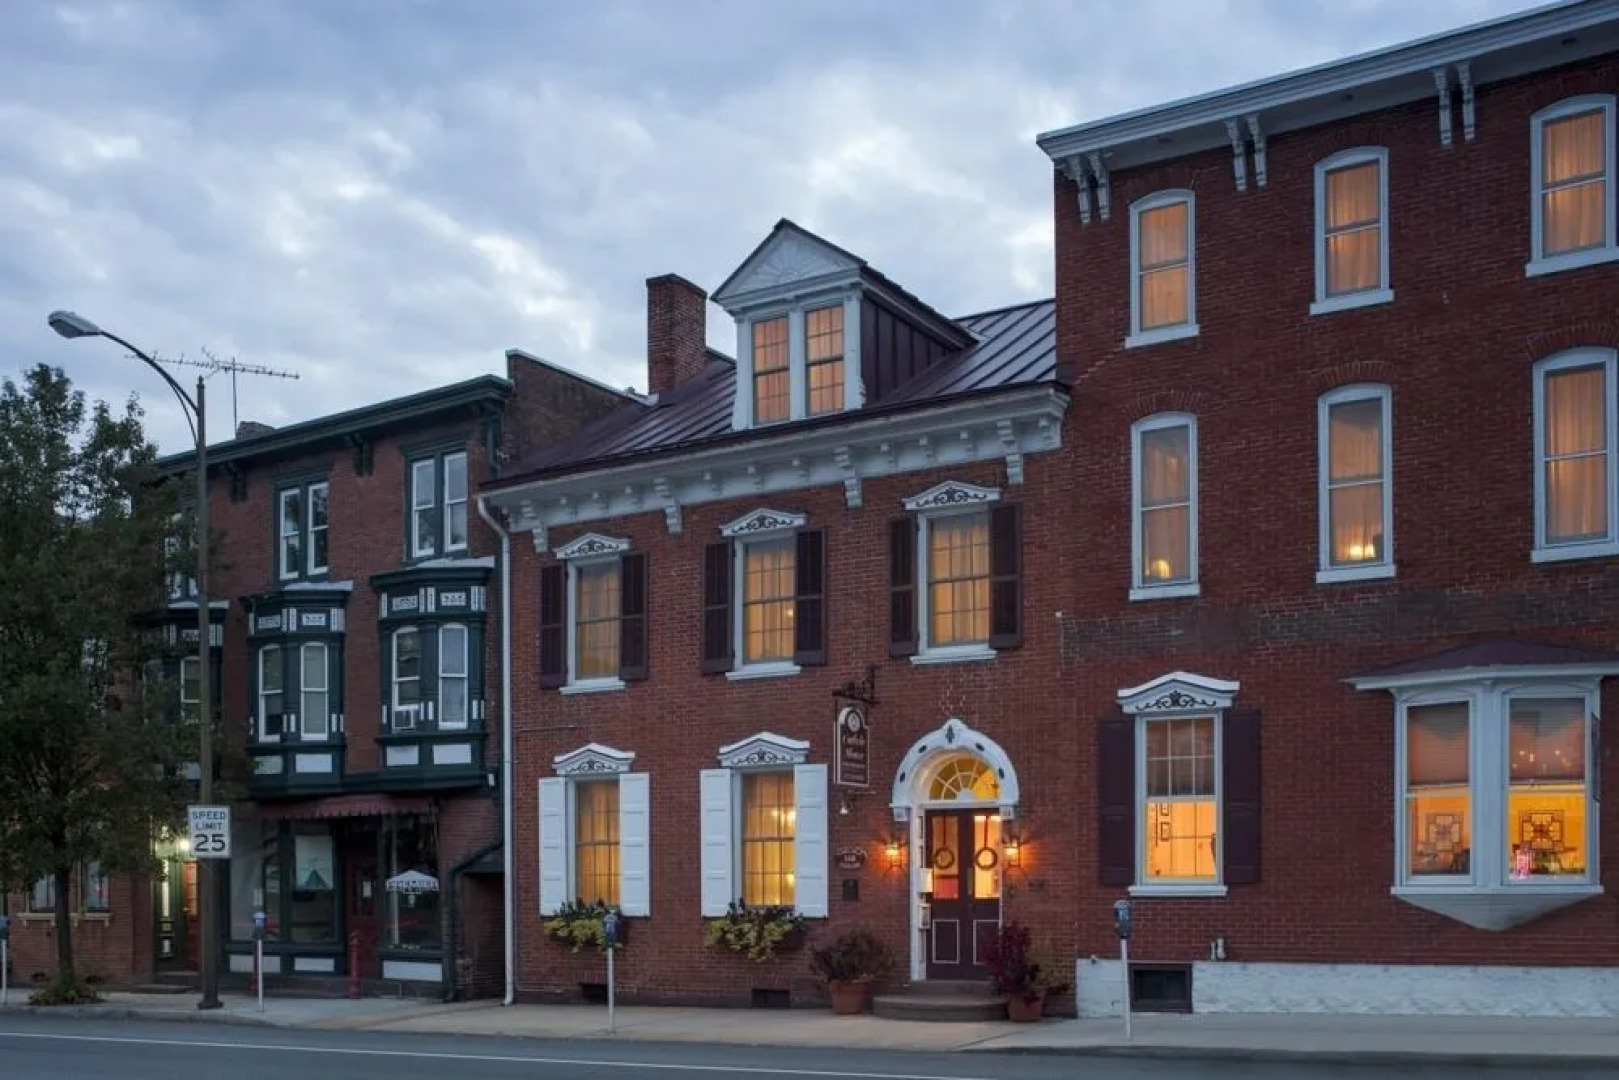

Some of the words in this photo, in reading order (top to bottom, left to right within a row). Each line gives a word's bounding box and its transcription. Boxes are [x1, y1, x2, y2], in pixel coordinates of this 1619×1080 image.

[192, 810, 226, 820] SPEED
[195, 821, 223, 830] LIMIT
[194, 833, 226, 852] 25
